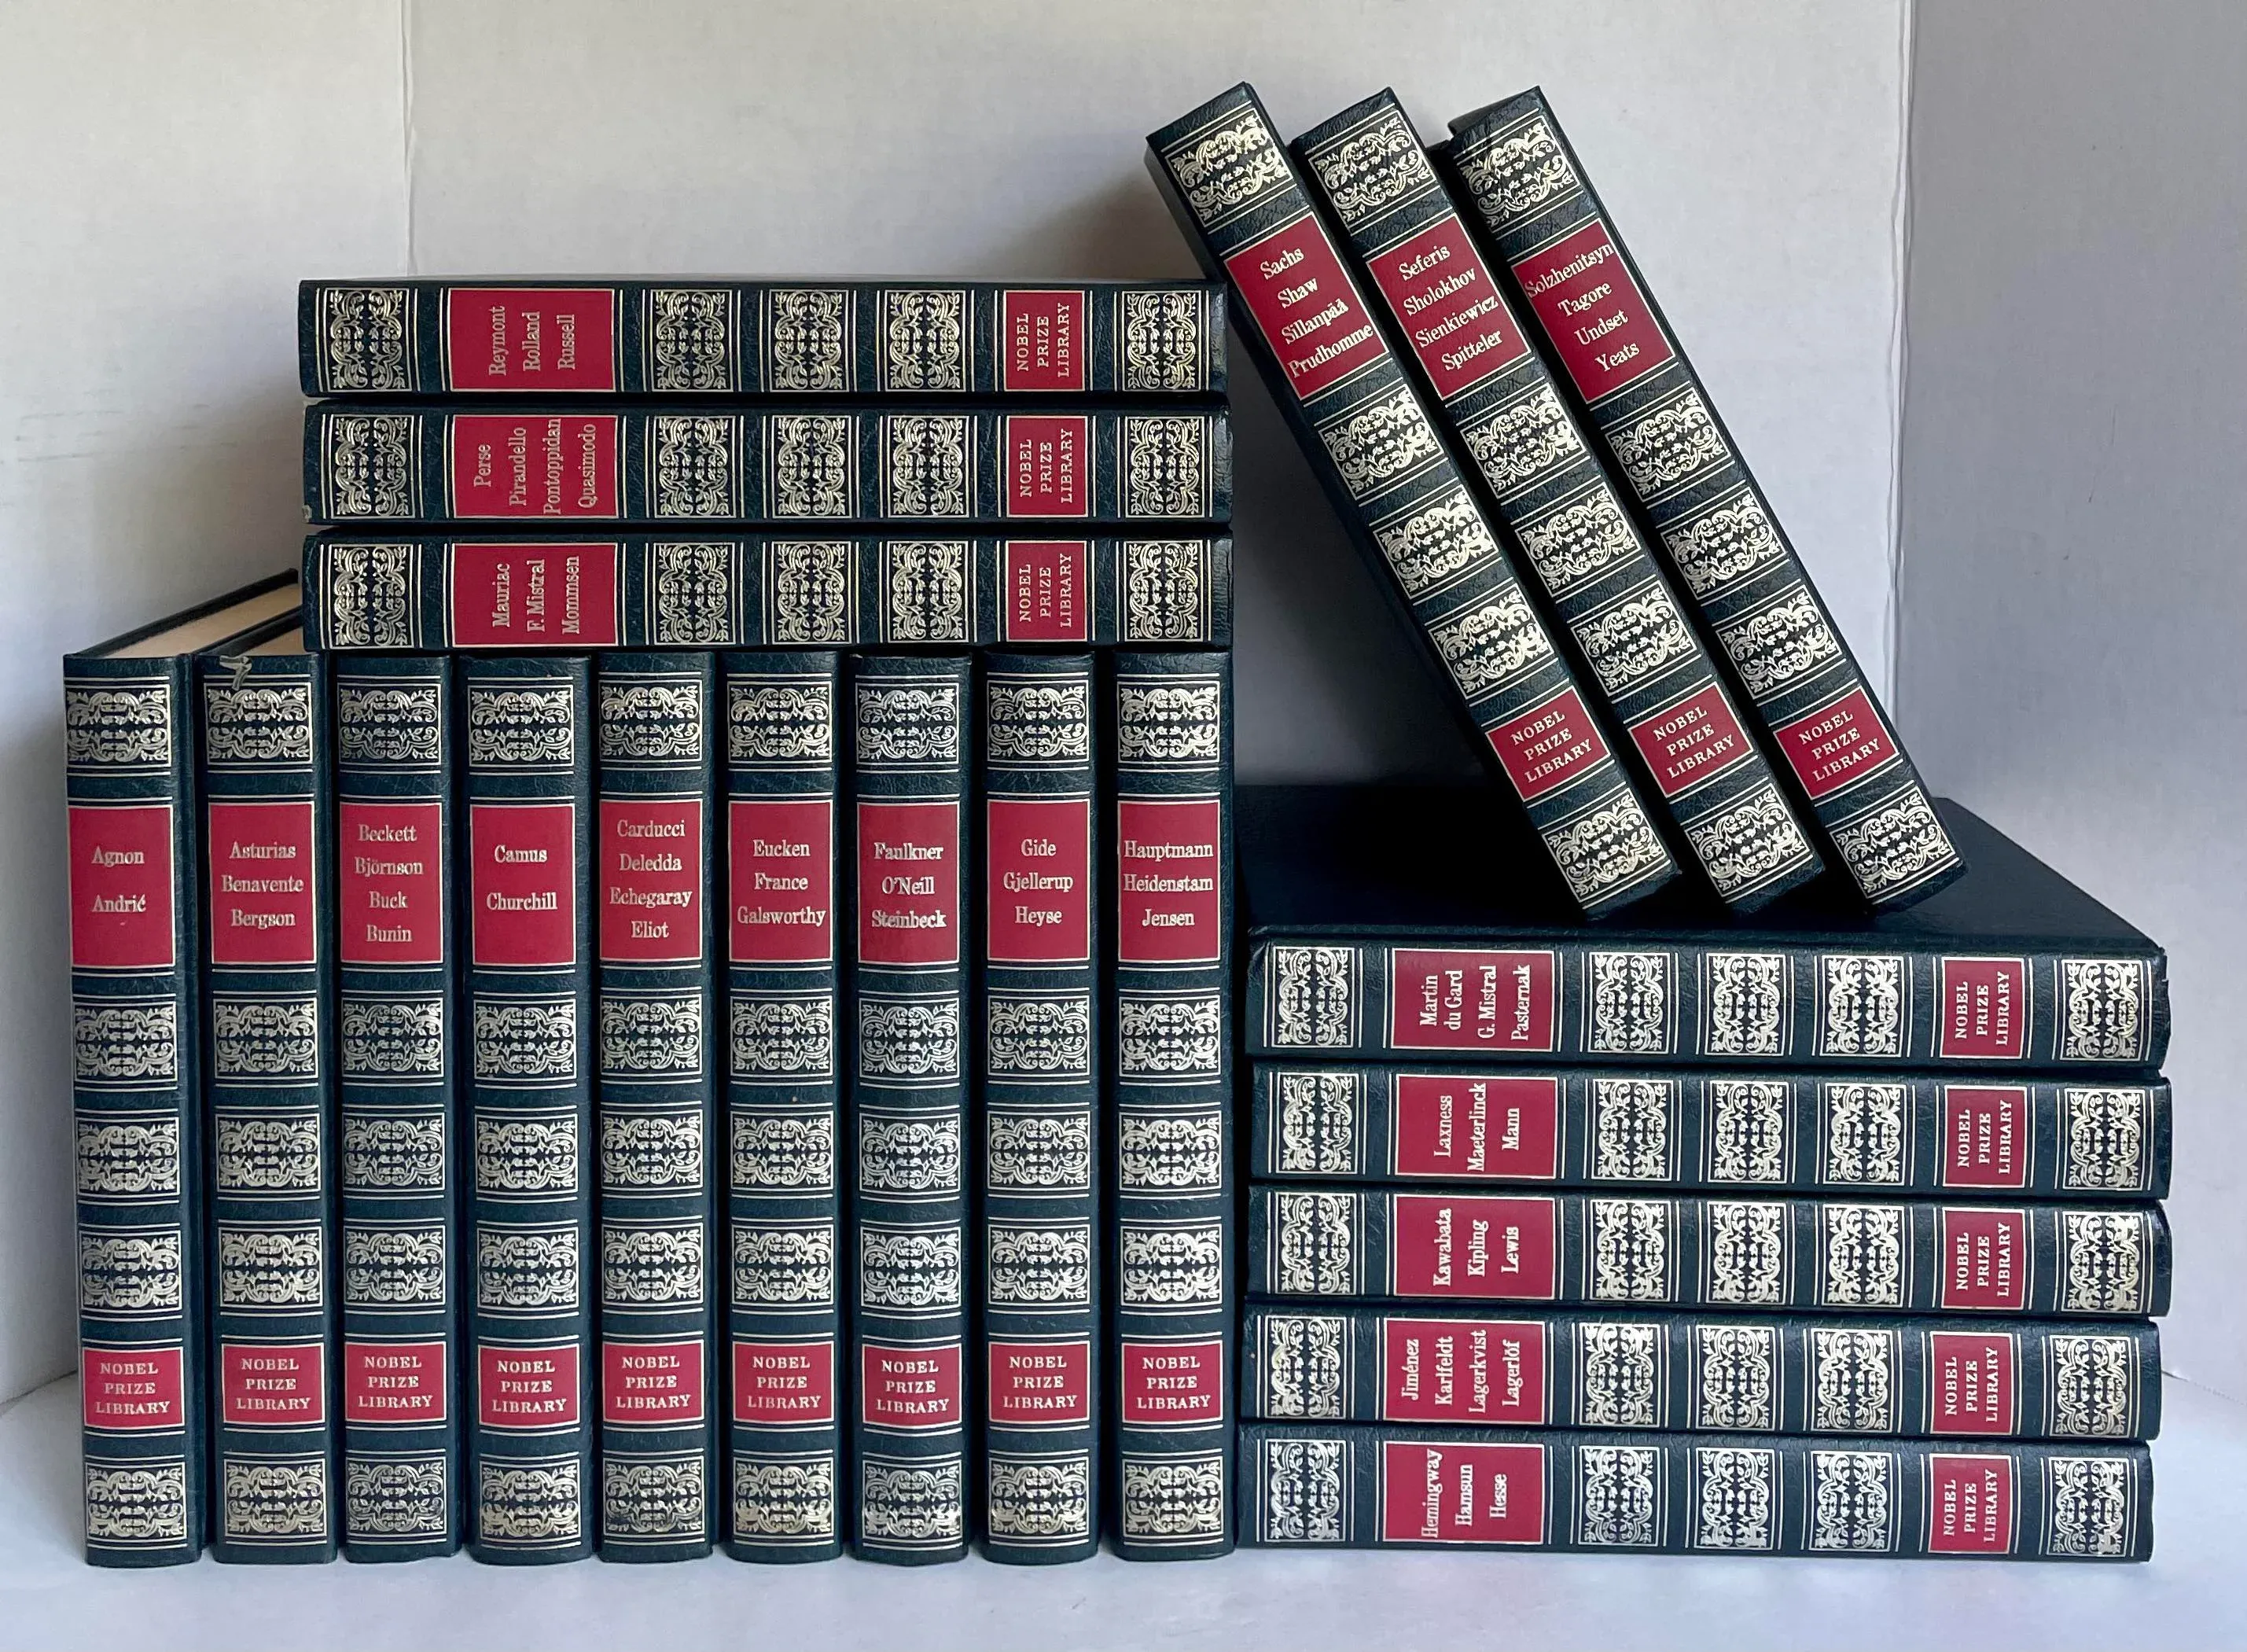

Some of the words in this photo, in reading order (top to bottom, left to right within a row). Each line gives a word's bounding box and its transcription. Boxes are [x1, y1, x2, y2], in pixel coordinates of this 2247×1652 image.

[1260, 248, 1304, 280] Sachs
[1398, 245, 1451, 281] Seferis
[1524, 244, 1614, 297] Solzhenitsyn
[1277, 278, 1318, 309] Shaw
[1403, 267, 1476, 317] Sholokhov
[1557, 282, 1613, 317] Tagore
[1415, 295, 1499, 348] Sienkiewicz
[1573, 308, 1629, 345] Undset
[488, 305, 509, 376] Reymont
[521, 311, 541, 372] Rolland
[556, 314, 576, 370] Russell
[1016, 313, 1029, 372] NOBEL
[1036, 315, 1050, 368] PRIZE
[1057, 302, 1070, 378] LIBRARY
[1288, 324, 1374, 378] Prudhomme
[1441, 329, 1503, 371] Spitteler
[1594, 342, 1640, 372] Yeats
[473, 444, 492, 488] Perse
[507, 427, 527, 506] Pirandello
[542, 418, 565, 514] Pontoppidan
[577, 423, 598, 509] Quasimodo
[1019, 439, 1032, 498] NOBEL
[1039, 441, 1053, 494] PRIZE
[1060, 428, 1073, 503] LIBRARY
[491, 563, 510, 627] Mauriac
[525, 558, 546, 616] Mistral
[561, 555, 580, 635] Mommsen
[1018, 564, 1032, 623] NOBEL
[1039, 567, 1052, 618] PRIZE
[1059, 553, 1072, 628] LIBRARY
[526, 618, 546, 632] F.
[1510, 710, 1565, 746] NOBEL
[1653, 705, 1708, 741] NOBEL
[1666, 723, 1715, 757] PRIZE
[1798, 710, 1854, 745] NOBEL
[1523, 727, 1572, 761] PRIZE
[1524, 738, 1592, 783] LIBRARY
[1666, 733, 1734, 779] LIBRARY
[1811, 727, 1861, 760] PRIZE
[1812, 737, 1881, 782] LIBRARY
[359, 824, 417, 842] Beckett
[617, 819, 686, 837] Carducci
[91, 846, 145, 868] Agnon
[229, 841, 296, 859] Asturias
[494, 844, 548, 863] Camus
[619, 852, 683, 872] Deledda
[752, 839, 811, 857] Eucken
[873, 841, 944, 861] Faulkner
[1021, 838, 1057, 857] Gide
[1124, 840, 1214, 863] Hauptmann
[221, 874, 304, 892] Benavente
[355, 856, 424, 878] Björnson
[754, 872, 809, 891] France
[1003, 871, 1074, 893] Gjellerup
[1123, 873, 1215, 892] Heidenstam
[91, 893, 147, 912] Andrić
[369, 890, 409, 909] Buck
[486, 891, 558, 911] Churchill
[609, 886, 693, 909] Echegaray
[230, 908, 296, 930] Bergson
[366, 924, 413, 943] Bunin
[631, 920, 670, 939] Eliot
[737, 905, 827, 928] Galsworthy
[871, 909, 947, 929] Steinbeck
[1014, 905, 1063, 927] Heyse
[1142, 908, 1196, 927] Jensen
[1419, 974, 1439, 1027] Martin
[1443, 968, 1463, 1009] Gard
[1477, 966, 1496, 1021] Mistral
[1510, 964, 1531, 1041] Pasternak
[1443, 1011, 1462, 1031] du
[1955, 981, 1969, 1039] NOBEL
[1976, 984, 1989, 1036] PRIZE
[1995, 970, 2010, 1046] LIBRARY
[1477, 1023, 1495, 1039] G.
[1433, 1095, 1453, 1158] Laxness
[1467, 1083, 1486, 1172] Maeterlinck
[1501, 1107, 1521, 1151] Mann
[1956, 1109, 1971, 1168] NOBEL
[1978, 1113, 1991, 1164] PRIZE
[1998, 1099, 2012, 1175] LIBRARY
[1432, 1207, 1452, 1287] Kawabata
[1466, 1219, 1490, 1278] Kipling
[1500, 1226, 1520, 1275] Lewis
[1955, 1231, 1969, 1290] NOBEL
[1977, 1235, 1990, 1287] PRIZE
[1996, 1221, 2011, 1297] LIBRARY
[100, 1362, 159, 1375] NOBEL
[241, 1358, 300, 1371] NOBEL
[364, 1356, 422, 1369] NOBEL
[497, 1359, 556, 1374] NOBEL
[621, 1355, 680, 1369] NOBEL
[752, 1356, 811, 1370] NOBEL
[881, 1359, 940, 1374] NOBEL
[1009, 1355, 1068, 1369] NOBEL
[1142, 1355, 1201, 1370] NOBEL
[1400, 1338, 1420, 1401] Jiménez
[1434, 1335, 1454, 1406] Karlfeldt
[1468, 1329, 1490, 1414] Lagerkvist
[1501, 1338, 1524, 1407] Lagerlöf
[105, 1382, 156, 1395] PRIZE
[245, 1378, 296, 1391] PRIZE
[367, 1375, 419, 1389] PRIZE
[500, 1379, 553, 1393] PRIZE
[625, 1374, 678, 1389] PRIZE
[756, 1375, 807, 1389] PRIZE
[885, 1379, 936, 1394] PRIZE
[1013, 1374, 1065, 1389] PRIZE
[1146, 1375, 1198, 1390] PRIZE
[1944, 1356, 1958, 1416] NOBEL
[1965, 1360, 1978, 1413] PRIZE
[1985, 1346, 1999, 1422] LIBRARY
[96, 1400, 171, 1415] LIBRARY
[236, 1396, 311, 1411] LIBRARY
[358, 1394, 433, 1409] LIBRARY
[492, 1397, 568, 1414] LIBRARY
[616, 1393, 692, 1410] LIBRARY
[748, 1394, 822, 1410] LIBRARY
[877, 1397, 950, 1415] LIBRARY
[1003, 1394, 1079, 1410] LIBRARY
[1136, 1393, 1212, 1410] LIBRARY
[1421, 1448, 1443, 1538] Hemingway
[1454, 1464, 1473, 1527] Hamsun
[1488, 1473, 1508, 1519] Hesse
[1943, 1479, 1957, 1536] NOBEL
[1963, 1483, 1977, 1533] PRIZE
[1983, 1468, 1998, 1542] LIBRARY
